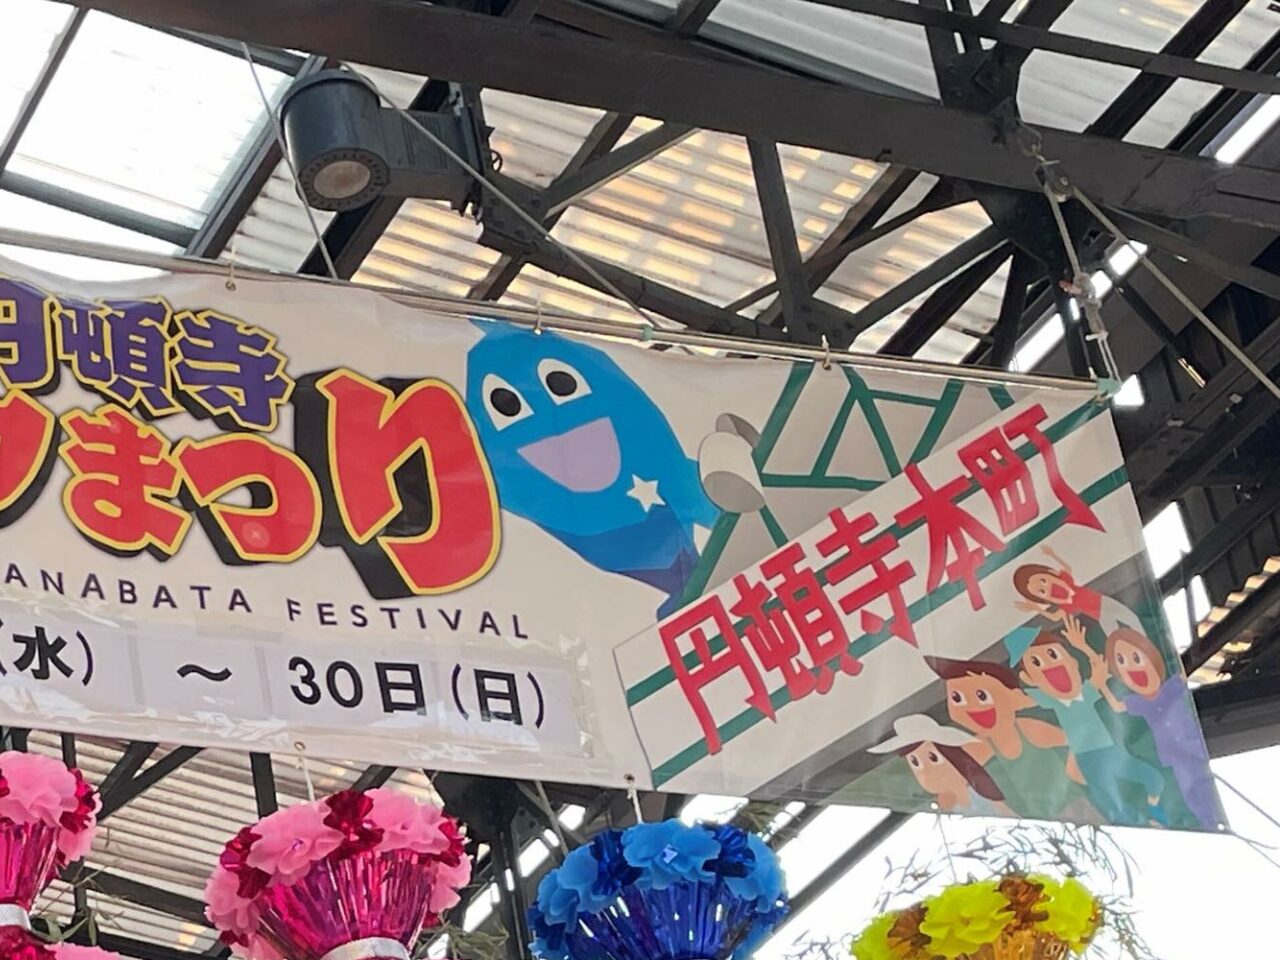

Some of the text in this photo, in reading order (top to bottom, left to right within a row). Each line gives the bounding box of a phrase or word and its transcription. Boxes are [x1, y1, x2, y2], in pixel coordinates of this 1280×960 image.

[286, 598, 529, 640] FESTIVAL
[658, 403, 1107, 756] 円頓寺本町
